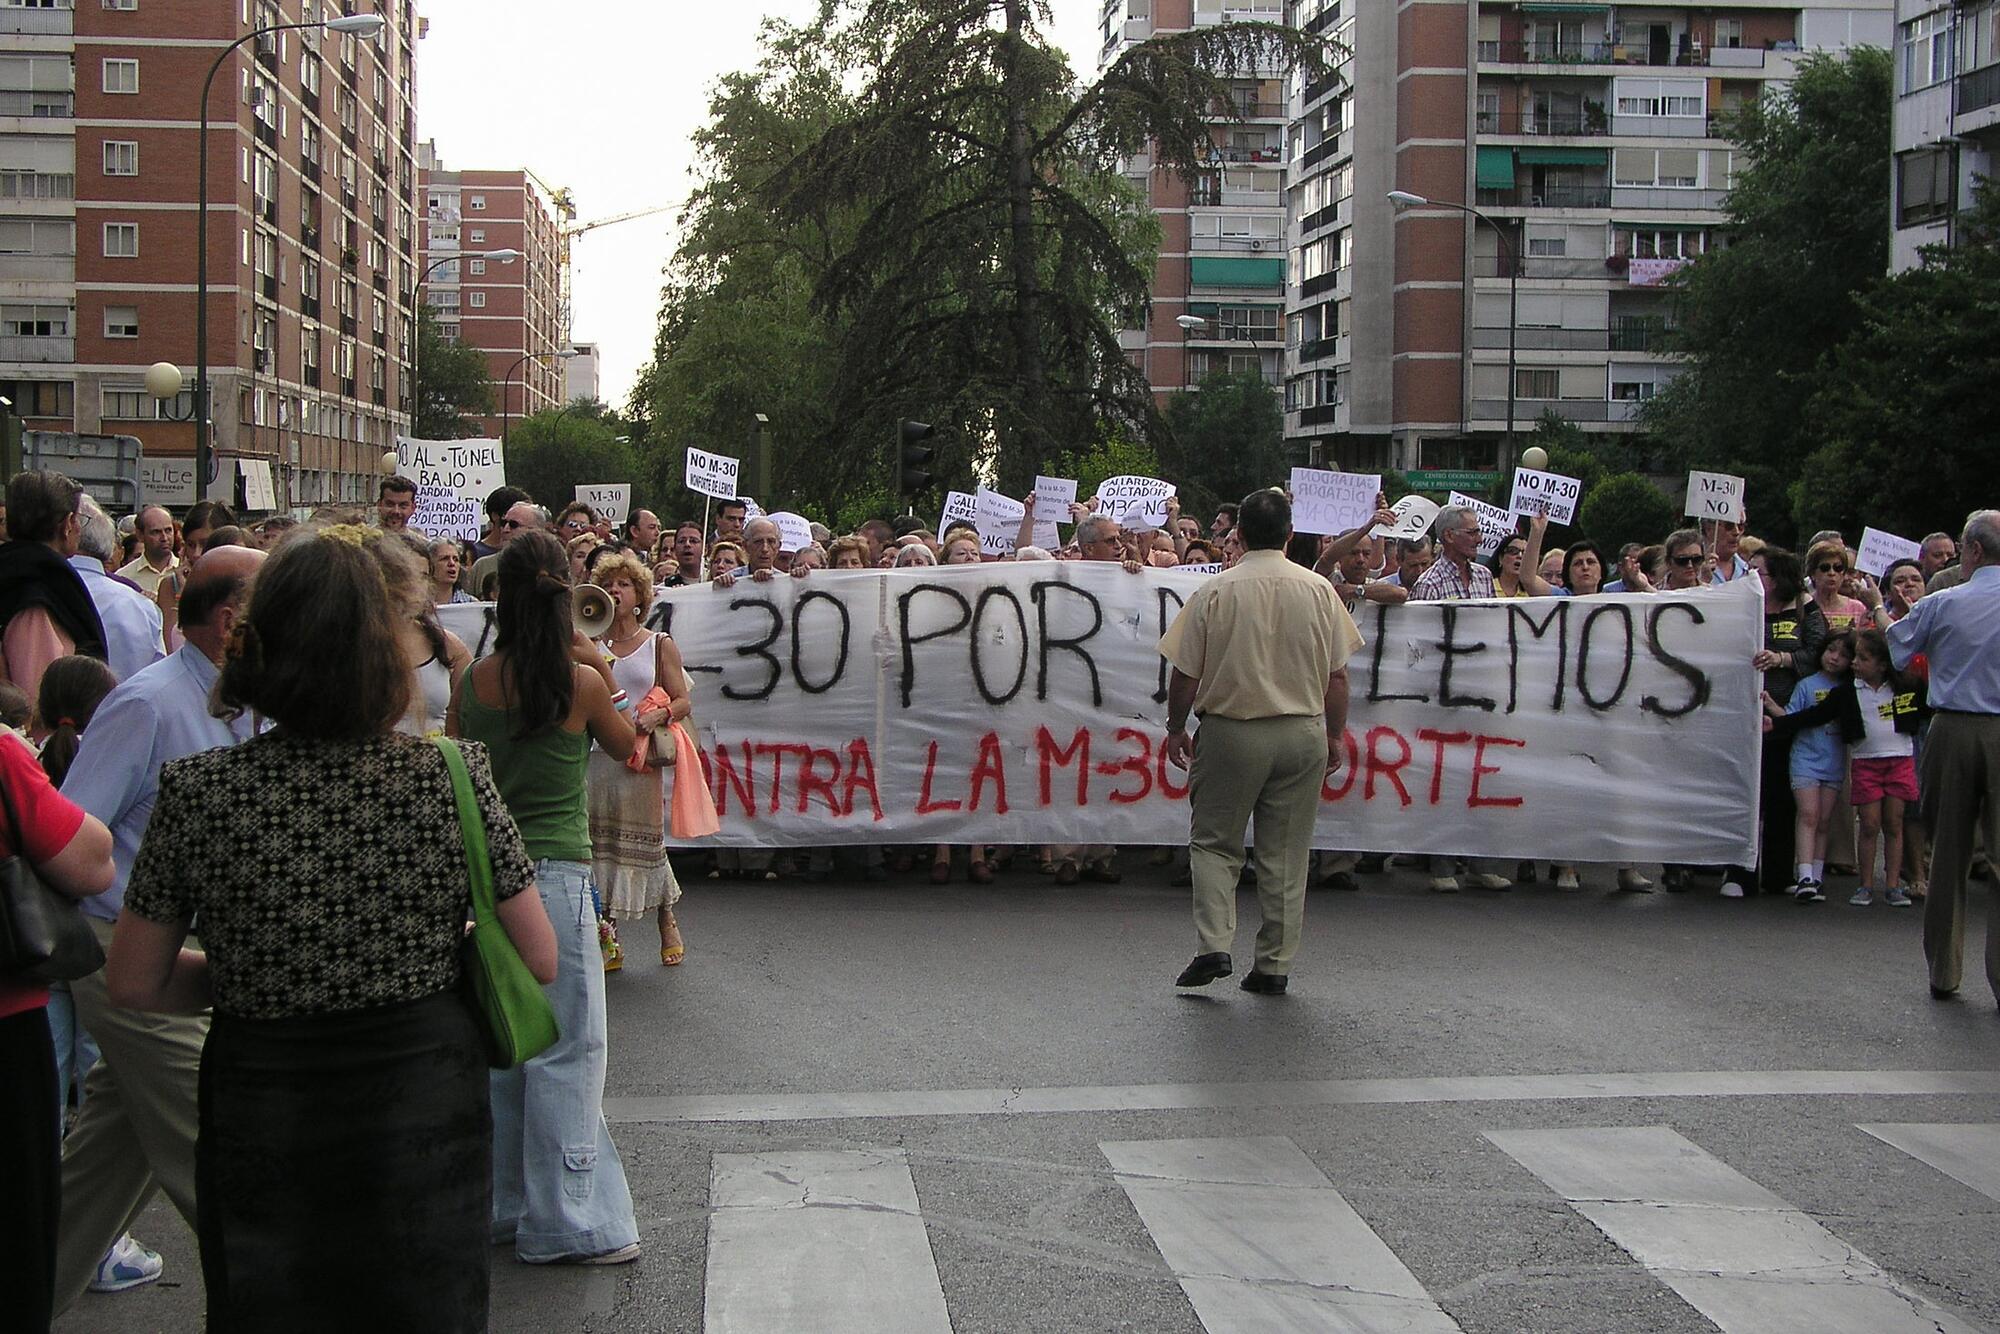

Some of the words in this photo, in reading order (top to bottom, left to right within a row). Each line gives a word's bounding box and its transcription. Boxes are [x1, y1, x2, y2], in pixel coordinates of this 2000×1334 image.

[413, 447, 436, 468] AL
[447, 447, 501, 468] TÚNEL
[690, 453, 706, 469] NO
[709, 459, 737, 477] M-30
[420, 470, 466, 488] BAJO
[1518, 473, 1539, 489] NO
[1543, 478, 1577, 499] M-30
[1700, 478, 1735, 496] M-30
[590, 490, 621, 501] M-30
[1106, 485, 1168, 497] DICTADOR
[954, 494, 977, 510] GALL
[1705, 499, 1729, 515] NO
[421, 513, 475, 525] DICTADOR
[596, 507, 616, 518] NO
[949, 505, 976, 518] ESPEC
[1402, 514, 1425, 533] NO
[900, 581, 1104, 708] POR
[1367, 600, 1713, 718] LEMOS
[917, 729, 1007, 816] LA
[1320, 725, 1526, 808] ORTE
